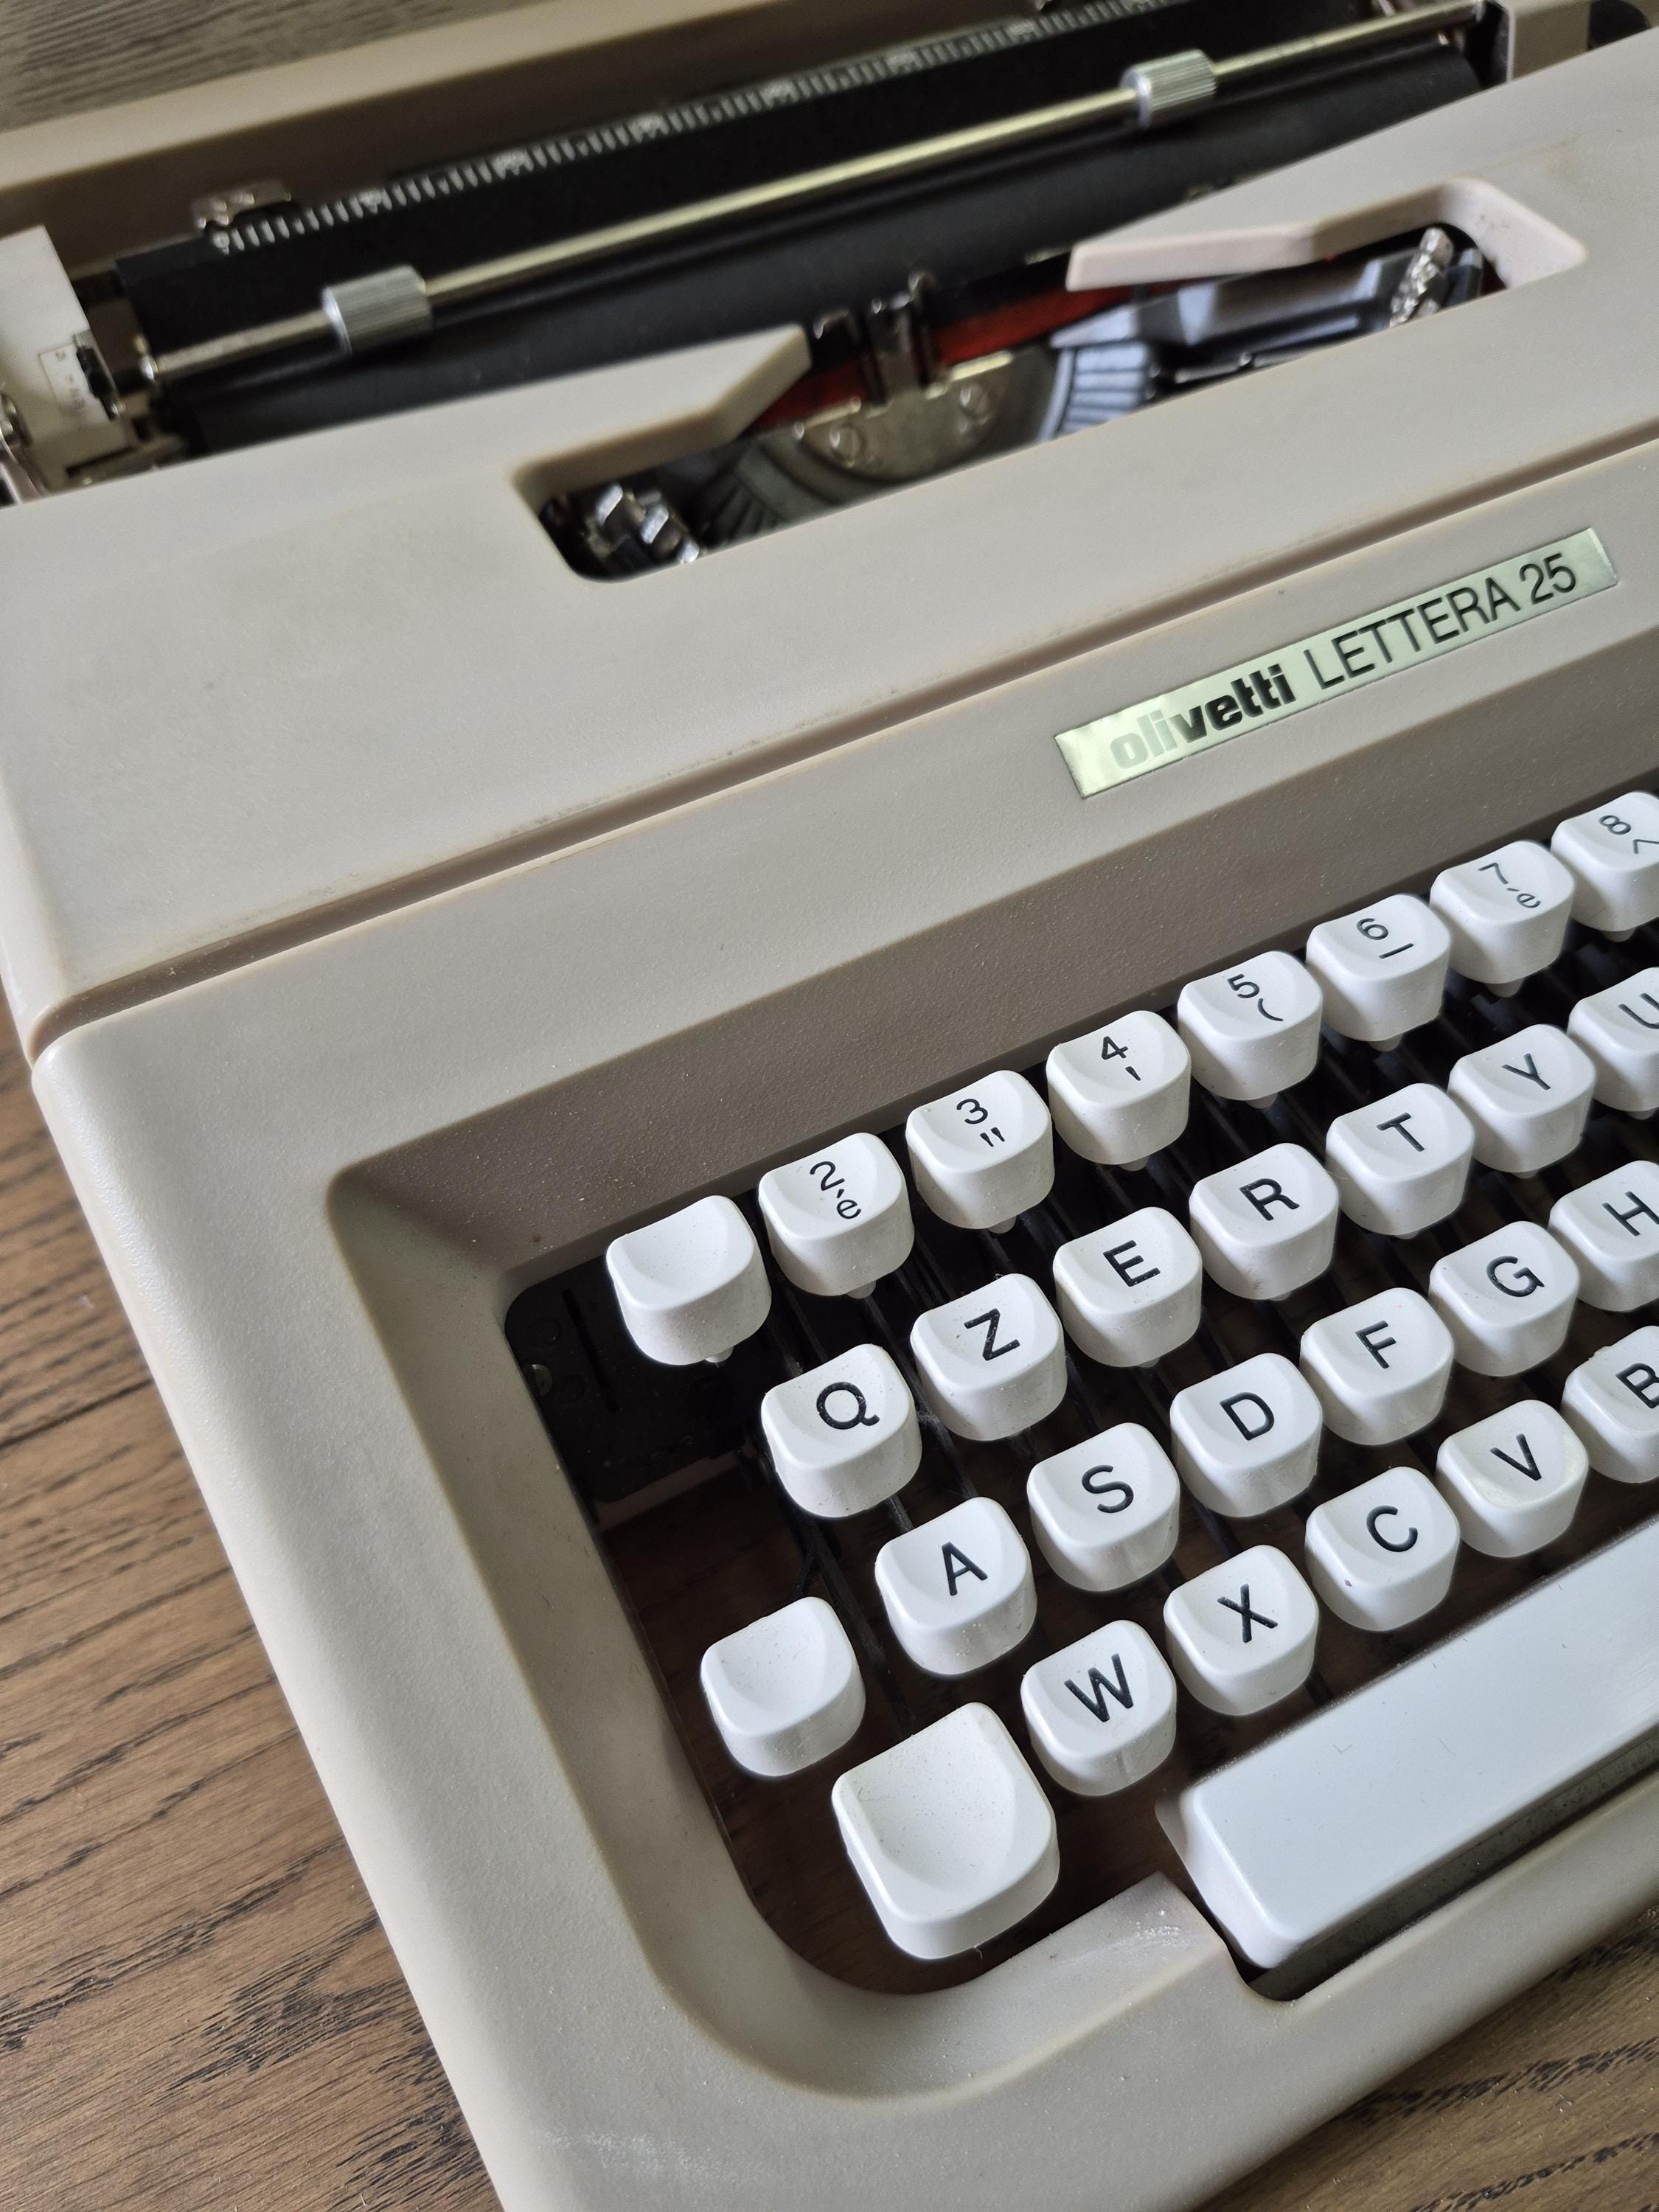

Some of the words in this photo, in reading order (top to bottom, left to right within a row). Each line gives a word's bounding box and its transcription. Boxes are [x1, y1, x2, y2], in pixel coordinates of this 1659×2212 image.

[1110, 665, 1296, 771] olivetti
[1304, 579, 1520, 690] LETTERA
[1520, 552, 1578, 605] 25
[1600, 815, 1631, 835] 8
[1479, 863, 1508, 884] 7
[1357, 919, 1388, 940] 6
[1228, 974, 1259, 998] 5
[1618, 993, 1659, 1029] U
[1102, 1037, 1128, 1060] 4
[1503, 1054, 1551, 1090] Y
[956, 1099, 988, 1124] 3
[1377, 1113, 1425, 1152] T
[810, 1161, 844, 1191] 2
[1239, 1179, 1299, 1221] R
[1603, 1192, 1659, 1236] H
[1103, 1240, 1160, 1287] E
[1487, 1256, 1545, 1297] G
[964, 1309, 1020, 1361] Z
[1356, 1321, 1396, 1368] F
[816, 1382, 880, 1430] Q
[1616, 1363, 1659, 1408] B
[1220, 1393, 1274, 1441] D
[1491, 1434, 1542, 1481] V
[1082, 1466, 1133, 1513] S
[1367, 1506, 1418, 1552] C
[942, 1543, 987, 1596] A
[1217, 1585, 1278, 1643] X
[1065, 1655, 1133, 1722] W
